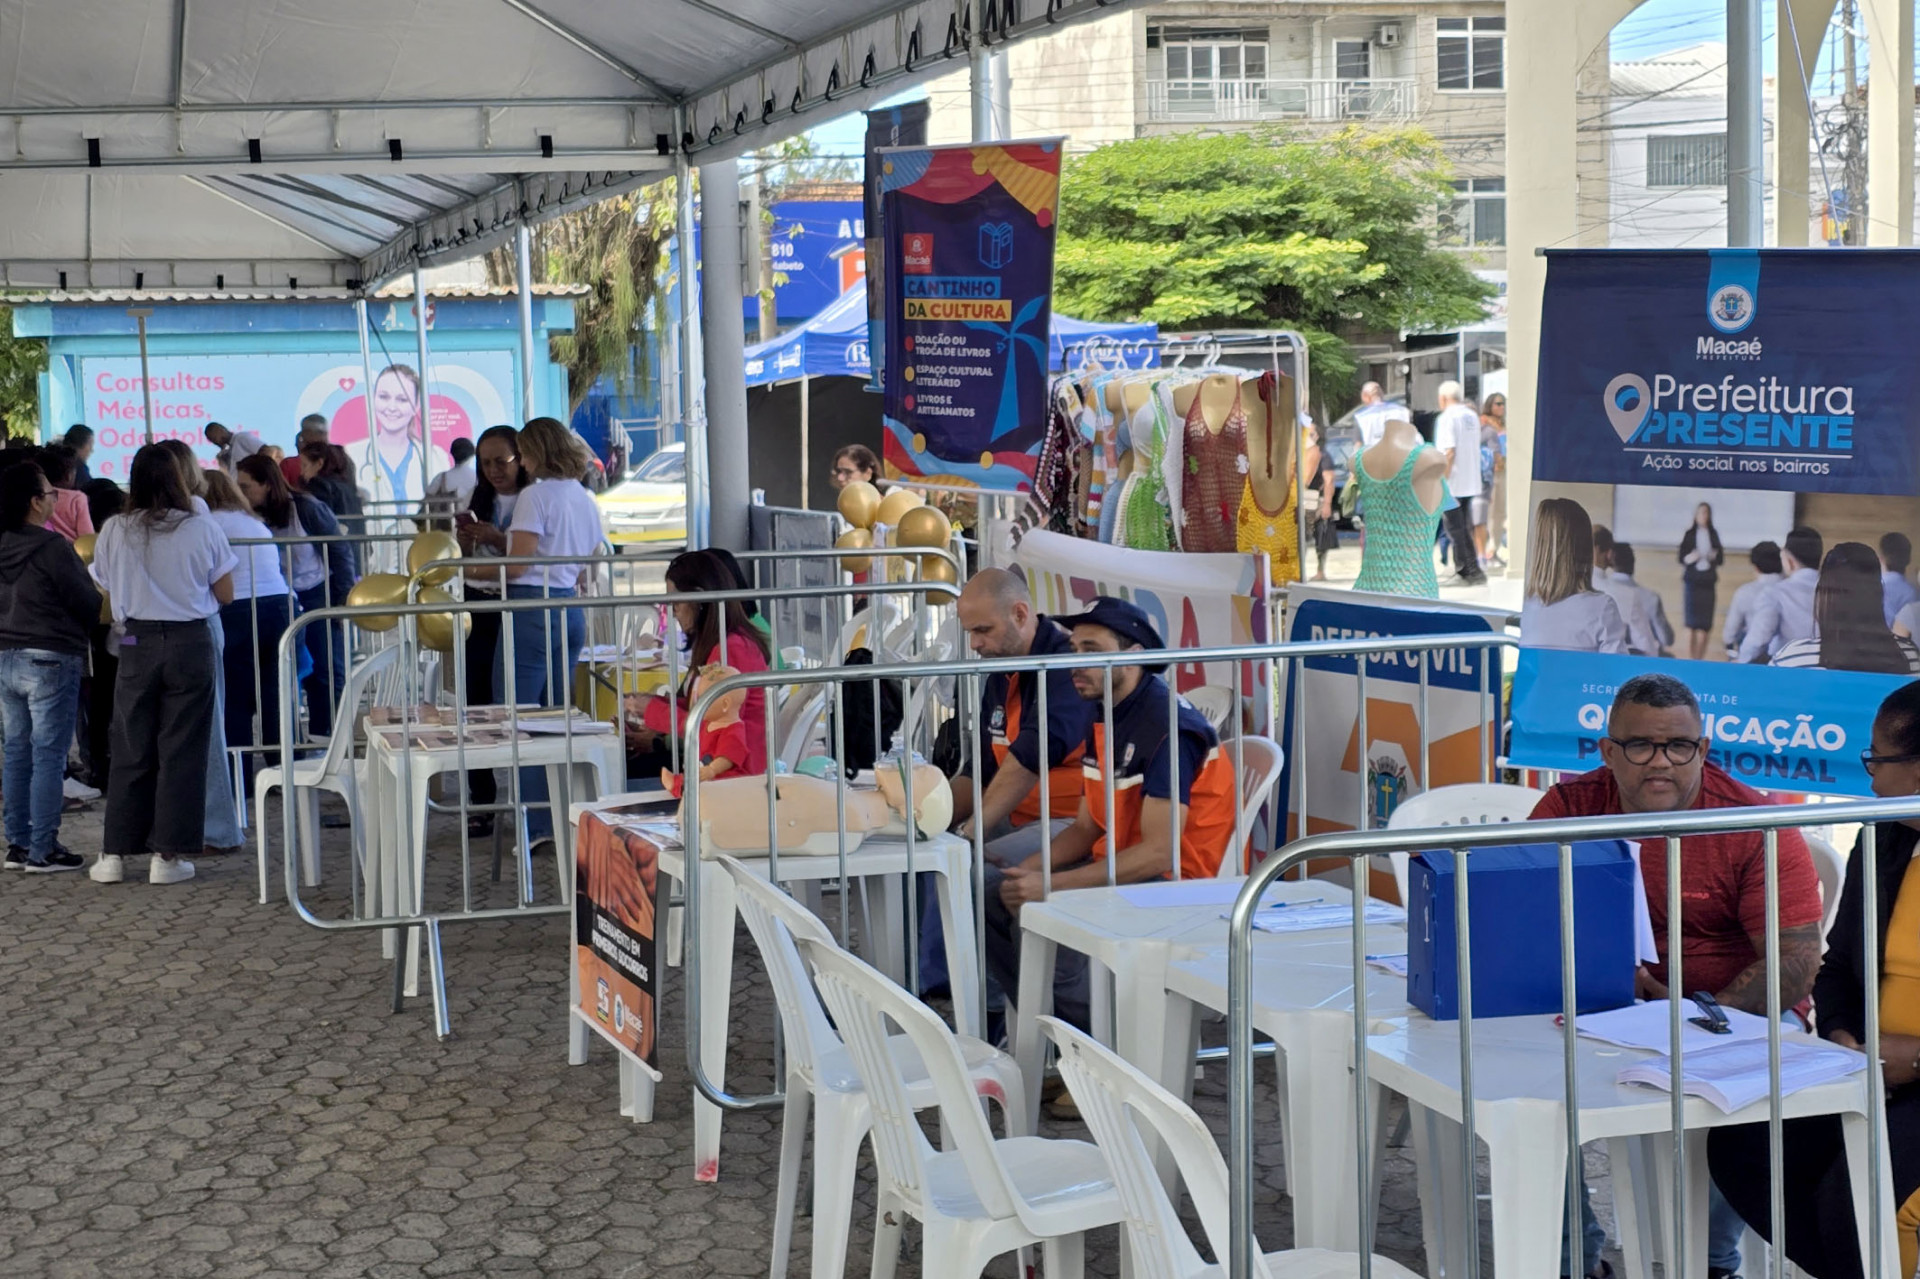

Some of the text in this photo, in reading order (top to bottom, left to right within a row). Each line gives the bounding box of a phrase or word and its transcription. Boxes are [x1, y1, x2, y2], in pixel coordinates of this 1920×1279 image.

[908, 281, 996, 297] CANTINHO
[908, 302, 1007, 320] DA CULTURA
[915, 333, 967, 348] DOAÇÃO OU
[1696, 336, 1762, 356] Macaé
[916, 346, 991, 358] TROCA DE LIVROS
[916, 365, 993, 378] ESPAÇO CULTURAL
[96, 371, 225, 393] Consultas
[916, 375, 961, 388] LITERÁRIO
[917, 394, 953, 405] LIVROS E
[1652, 374, 1855, 416] Prefeitura
[917, 406, 976, 418] ARTESANATOS
[1642, 411, 1854, 449] PRESENTE
[1642, 454, 1831, 475] Ação social nos bairros
[1404, 645, 1473, 675] CVIL
[1722, 695, 1738, 706] DE
[1577, 703, 1847, 754] QICAÇÃO
